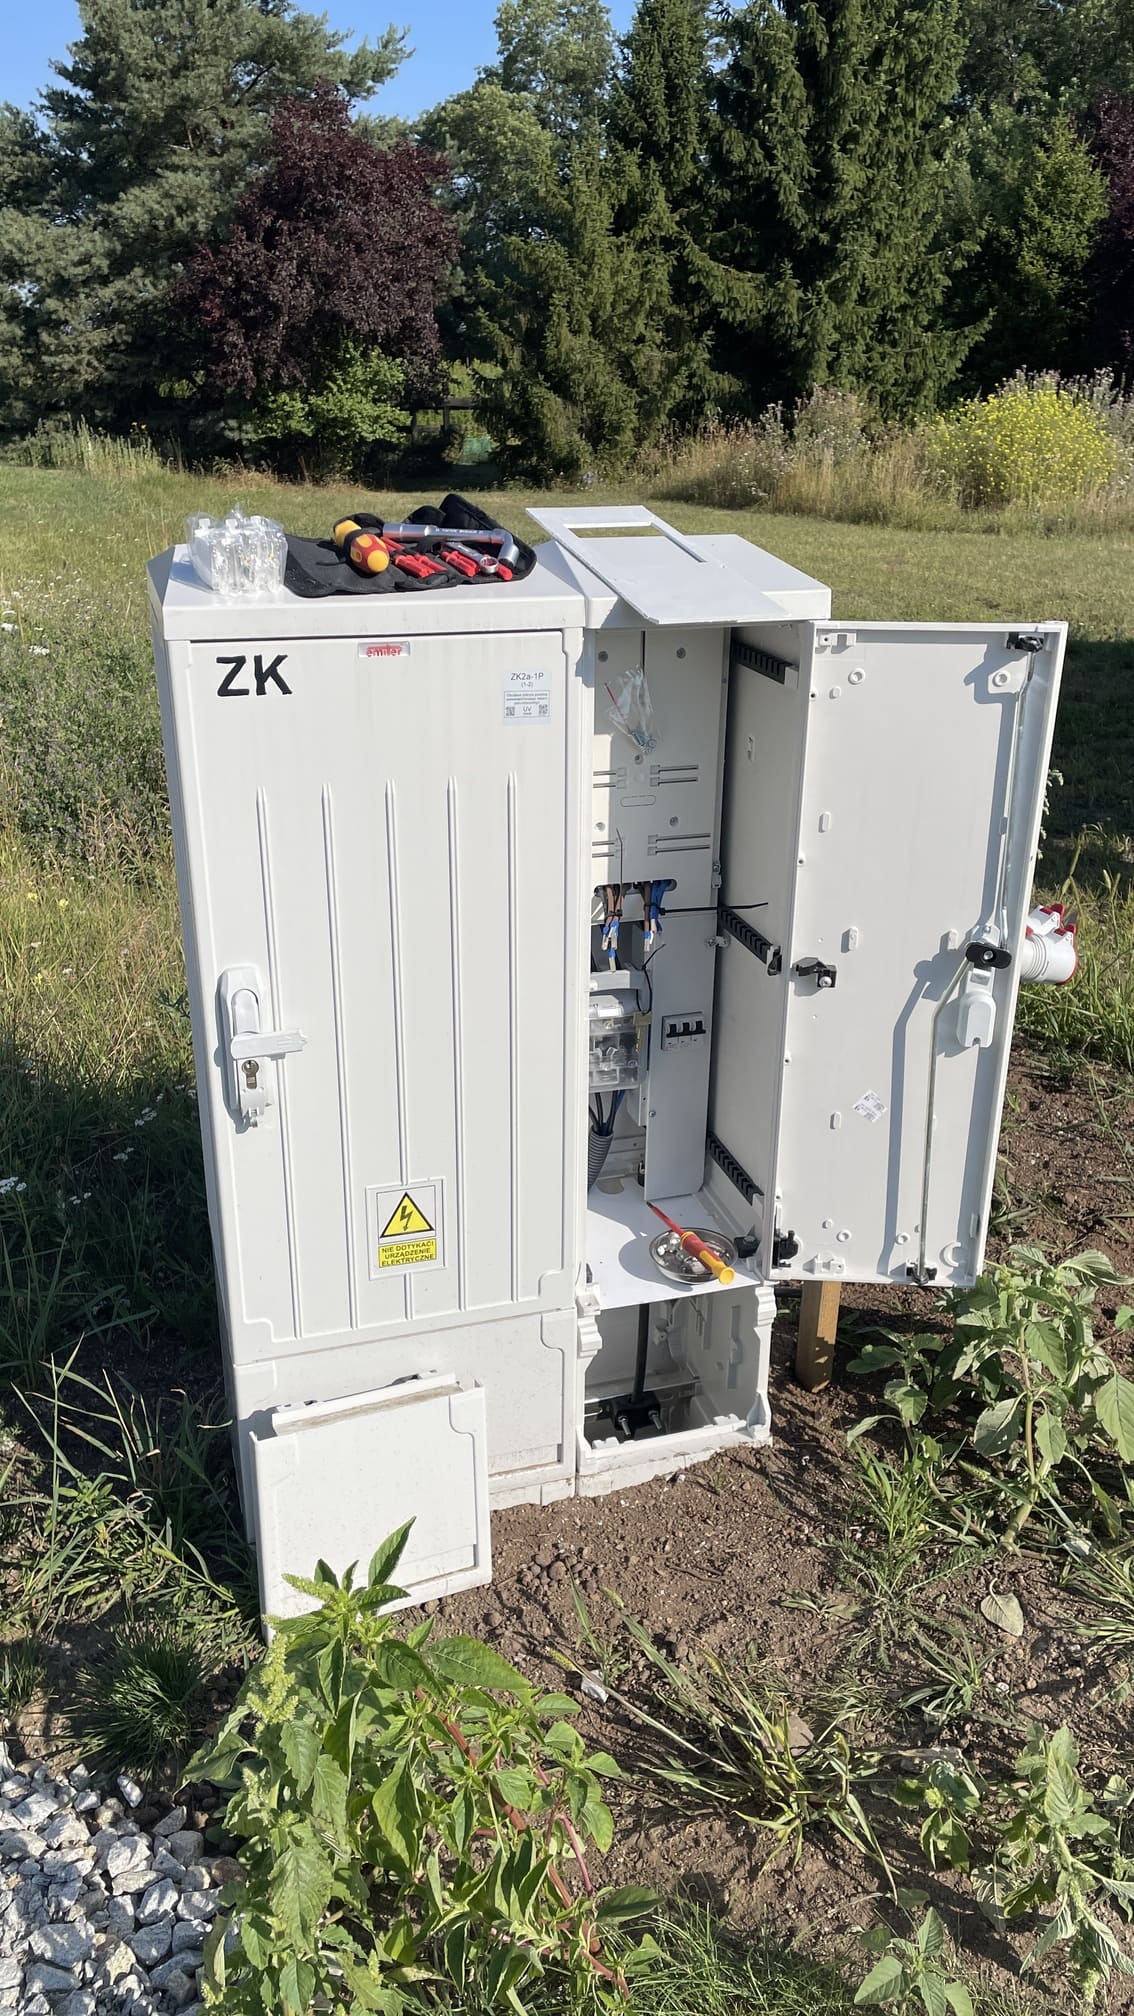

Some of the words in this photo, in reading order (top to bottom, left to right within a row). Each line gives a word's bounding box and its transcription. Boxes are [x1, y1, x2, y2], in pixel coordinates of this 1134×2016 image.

[216, 655, 292, 697] ZK
[381, 1253, 434, 1267] ELEKTRYCZNE
[384, 1248, 431, 1260] URZĄDZENIE
